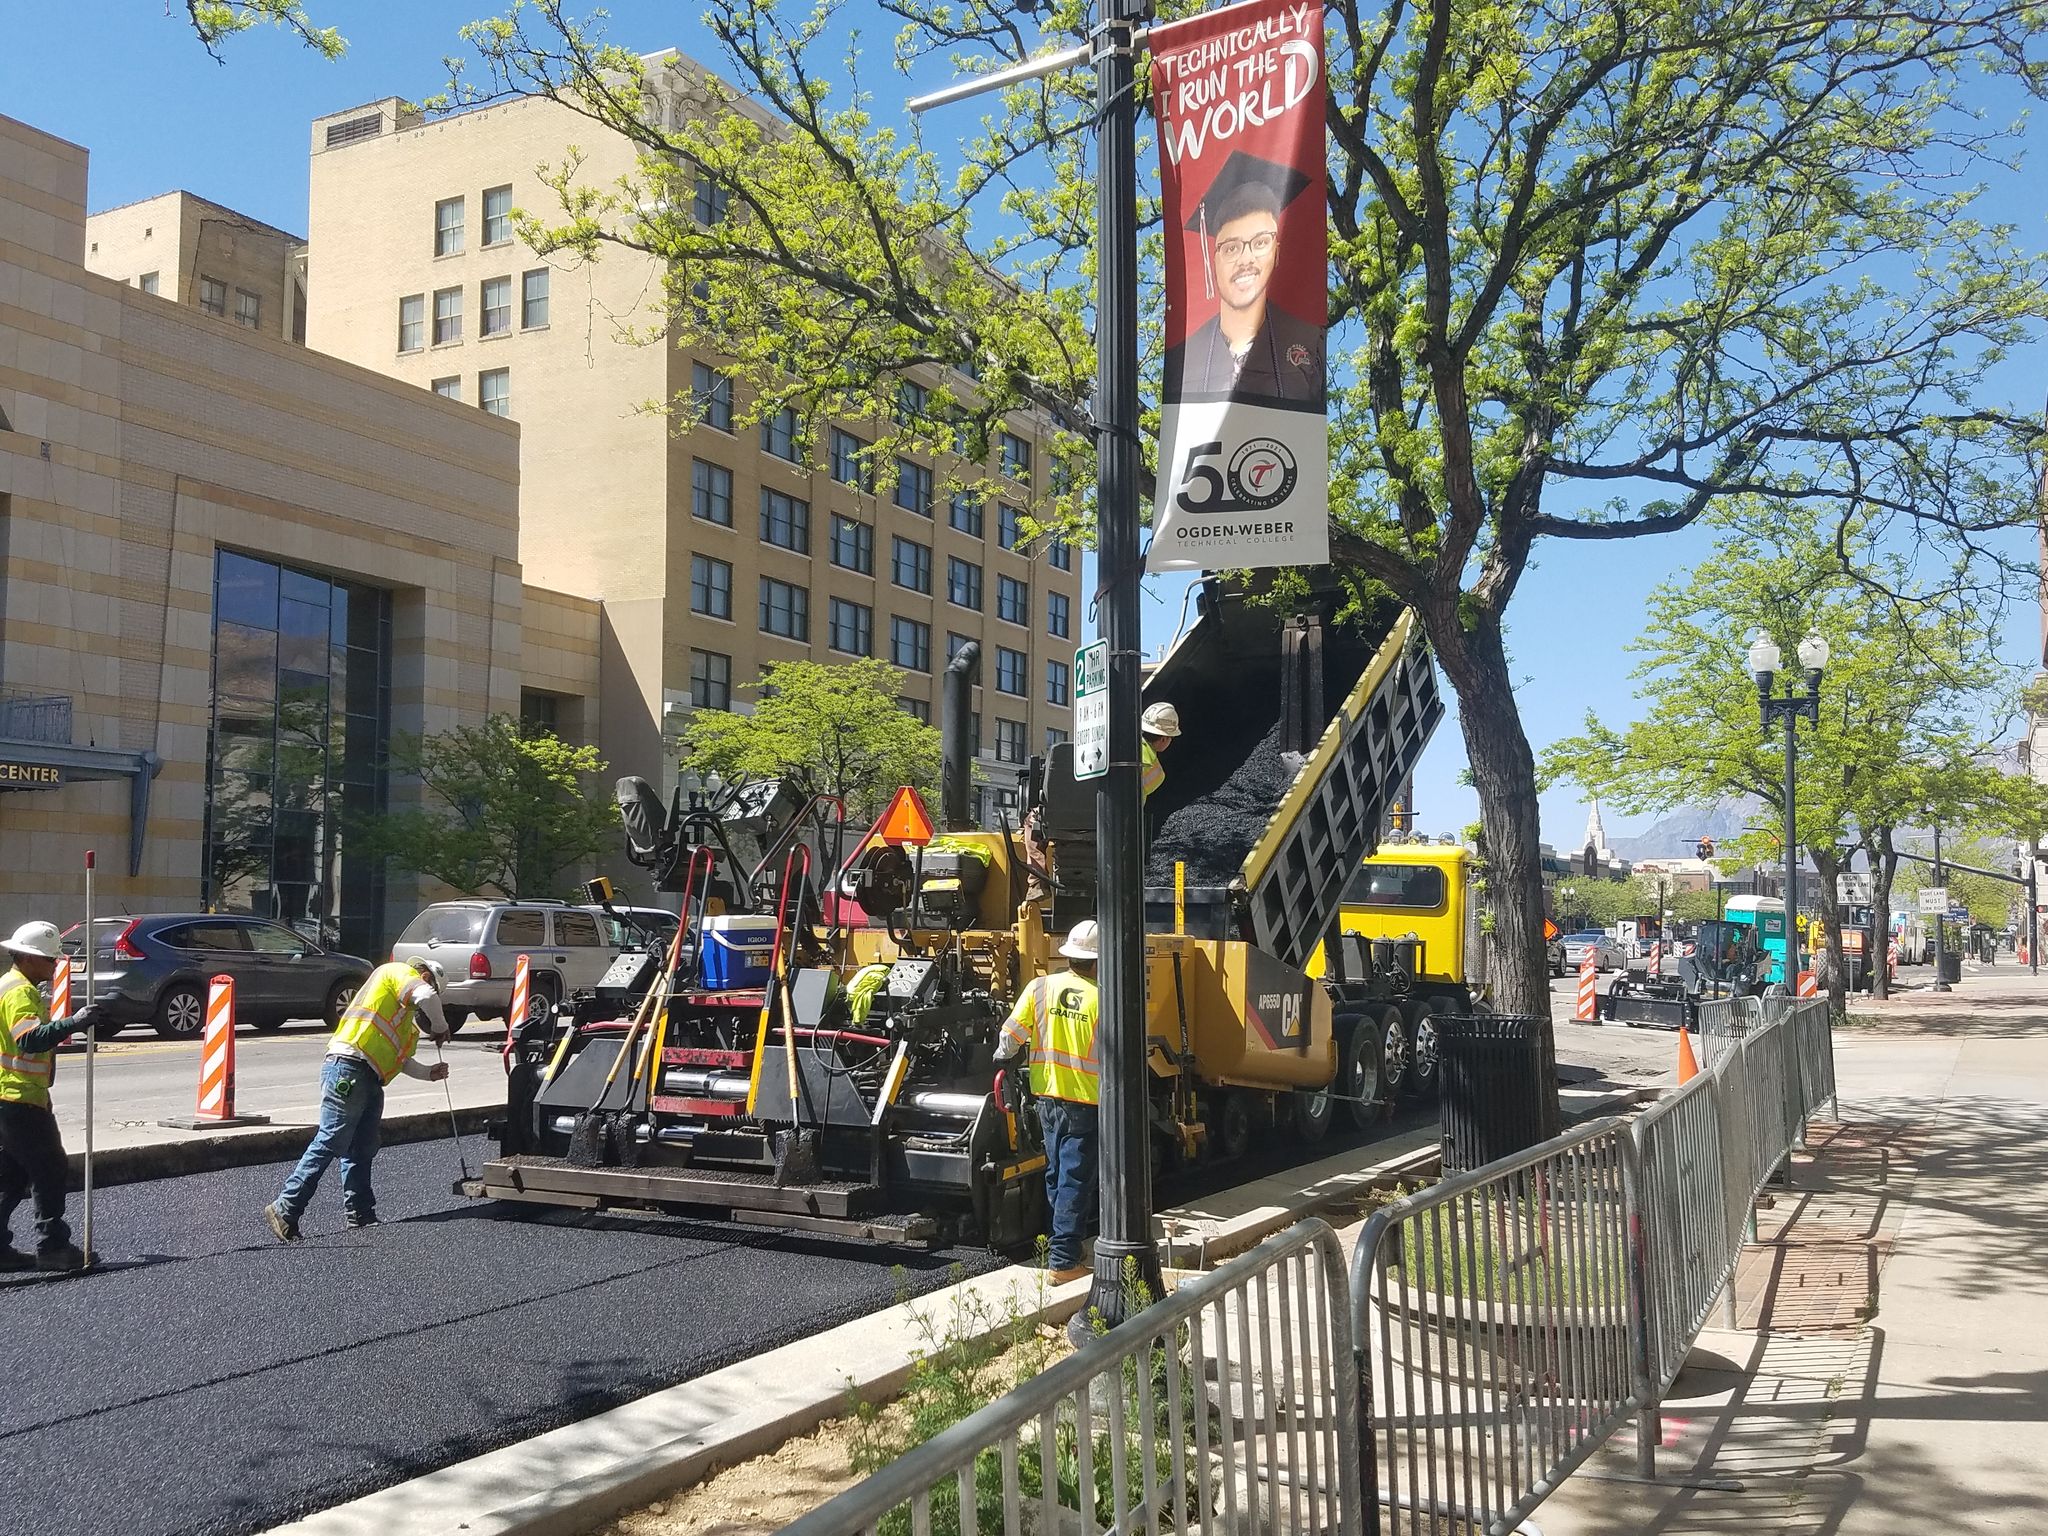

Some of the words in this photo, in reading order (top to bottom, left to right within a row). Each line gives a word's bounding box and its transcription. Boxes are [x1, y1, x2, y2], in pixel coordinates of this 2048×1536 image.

[1161, 2, 1310, 84] TECHNICALLY,
[1160, 90, 1172, 118] I
[1179, 65, 1228, 115] RUN
[1233, 47, 1278, 88] THE
[1164, 39, 1318, 166] WORLD
[1265, 443, 1282, 453] 2021
[1230, 477, 1267, 506] CELEBRATING
[1280, 475, 1293, 497] YEARS
[1176, 521, 1294, 540] OGDEN-WEBER
[1177, 538, 1238, 548] TECHNICAL
[1246, 535, 1295, 545] COLLEGE
[1076, 659, 1085, 691] 2
[1090, 650, 1100, 668] HR
[1086, 668, 1105, 691] PARKING
[0, 764, 59, 783] CENTER
[1258, 993, 1281, 1010] AP655D
[1049, 1007, 1089, 1023] GRANITE
